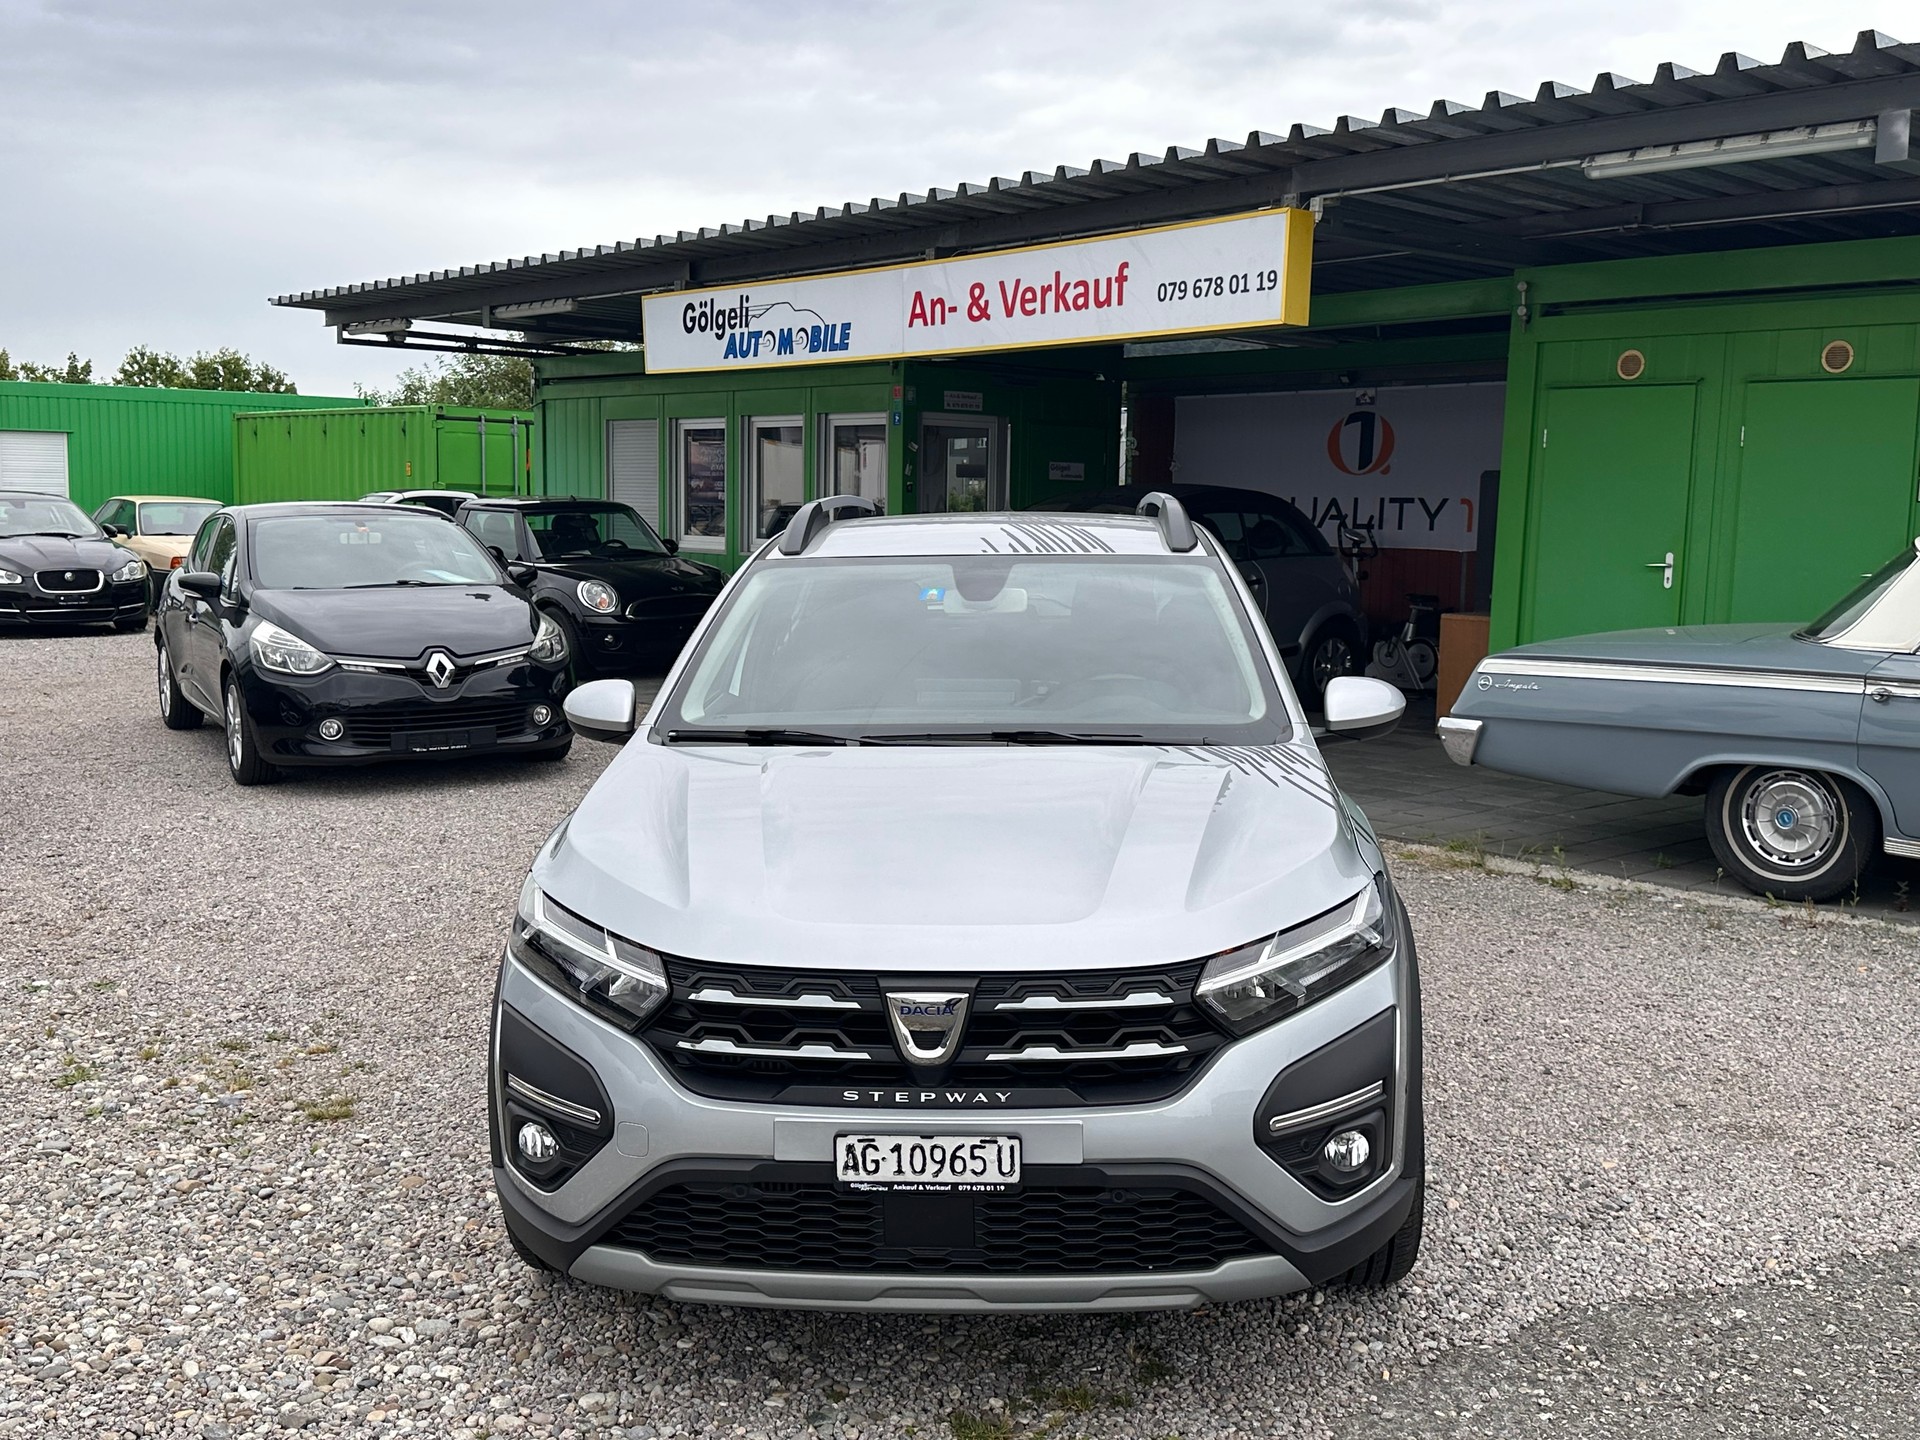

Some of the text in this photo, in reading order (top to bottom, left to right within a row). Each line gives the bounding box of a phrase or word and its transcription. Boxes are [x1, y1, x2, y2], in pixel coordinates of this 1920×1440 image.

[908, 261, 1130, 328] An- & Verkauf
[1157, 269, 1278, 302] 079 678 01 19
[683, 294, 750, 341] Gölgeli
[723, 322, 852, 360] AUTOMOBILE
[1460, 498, 1474, 533] 1
[1494, 678, 1541, 692] Impala
[900, 1003, 954, 1016] DACIA
[842, 1090, 1012, 1103] STEPWAY
